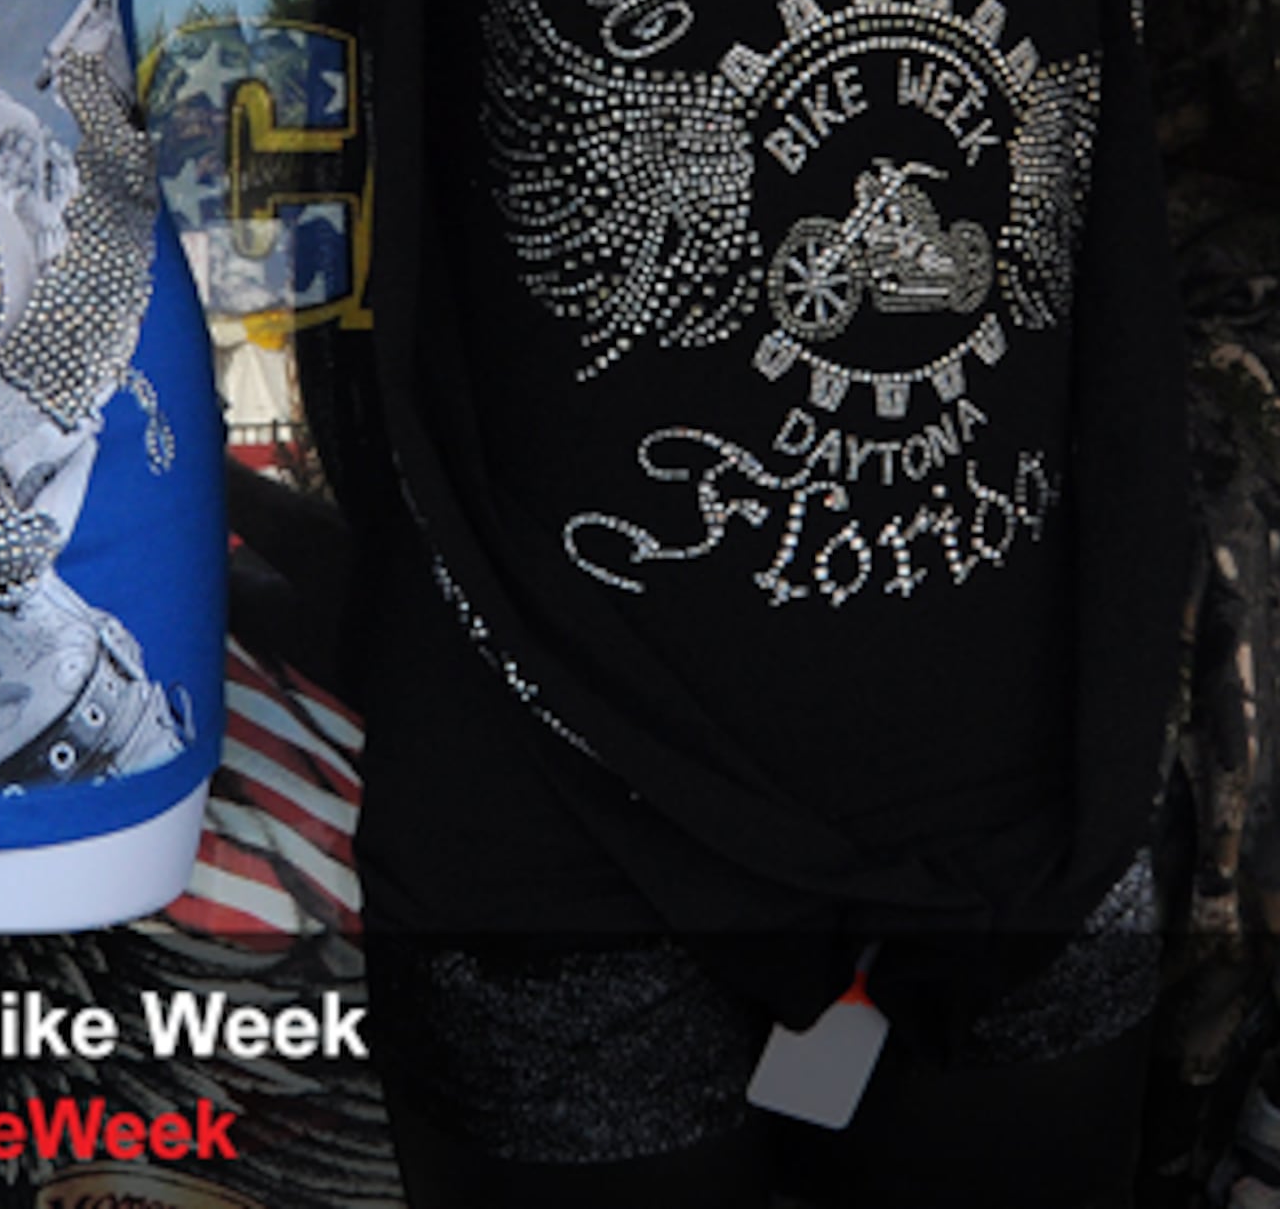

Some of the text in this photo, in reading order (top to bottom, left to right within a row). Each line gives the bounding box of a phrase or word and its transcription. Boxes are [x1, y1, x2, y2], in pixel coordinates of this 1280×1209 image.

[763, 55, 1003, 176] BIKE WEEK
[771, 398, 990, 486] DAYTONA
